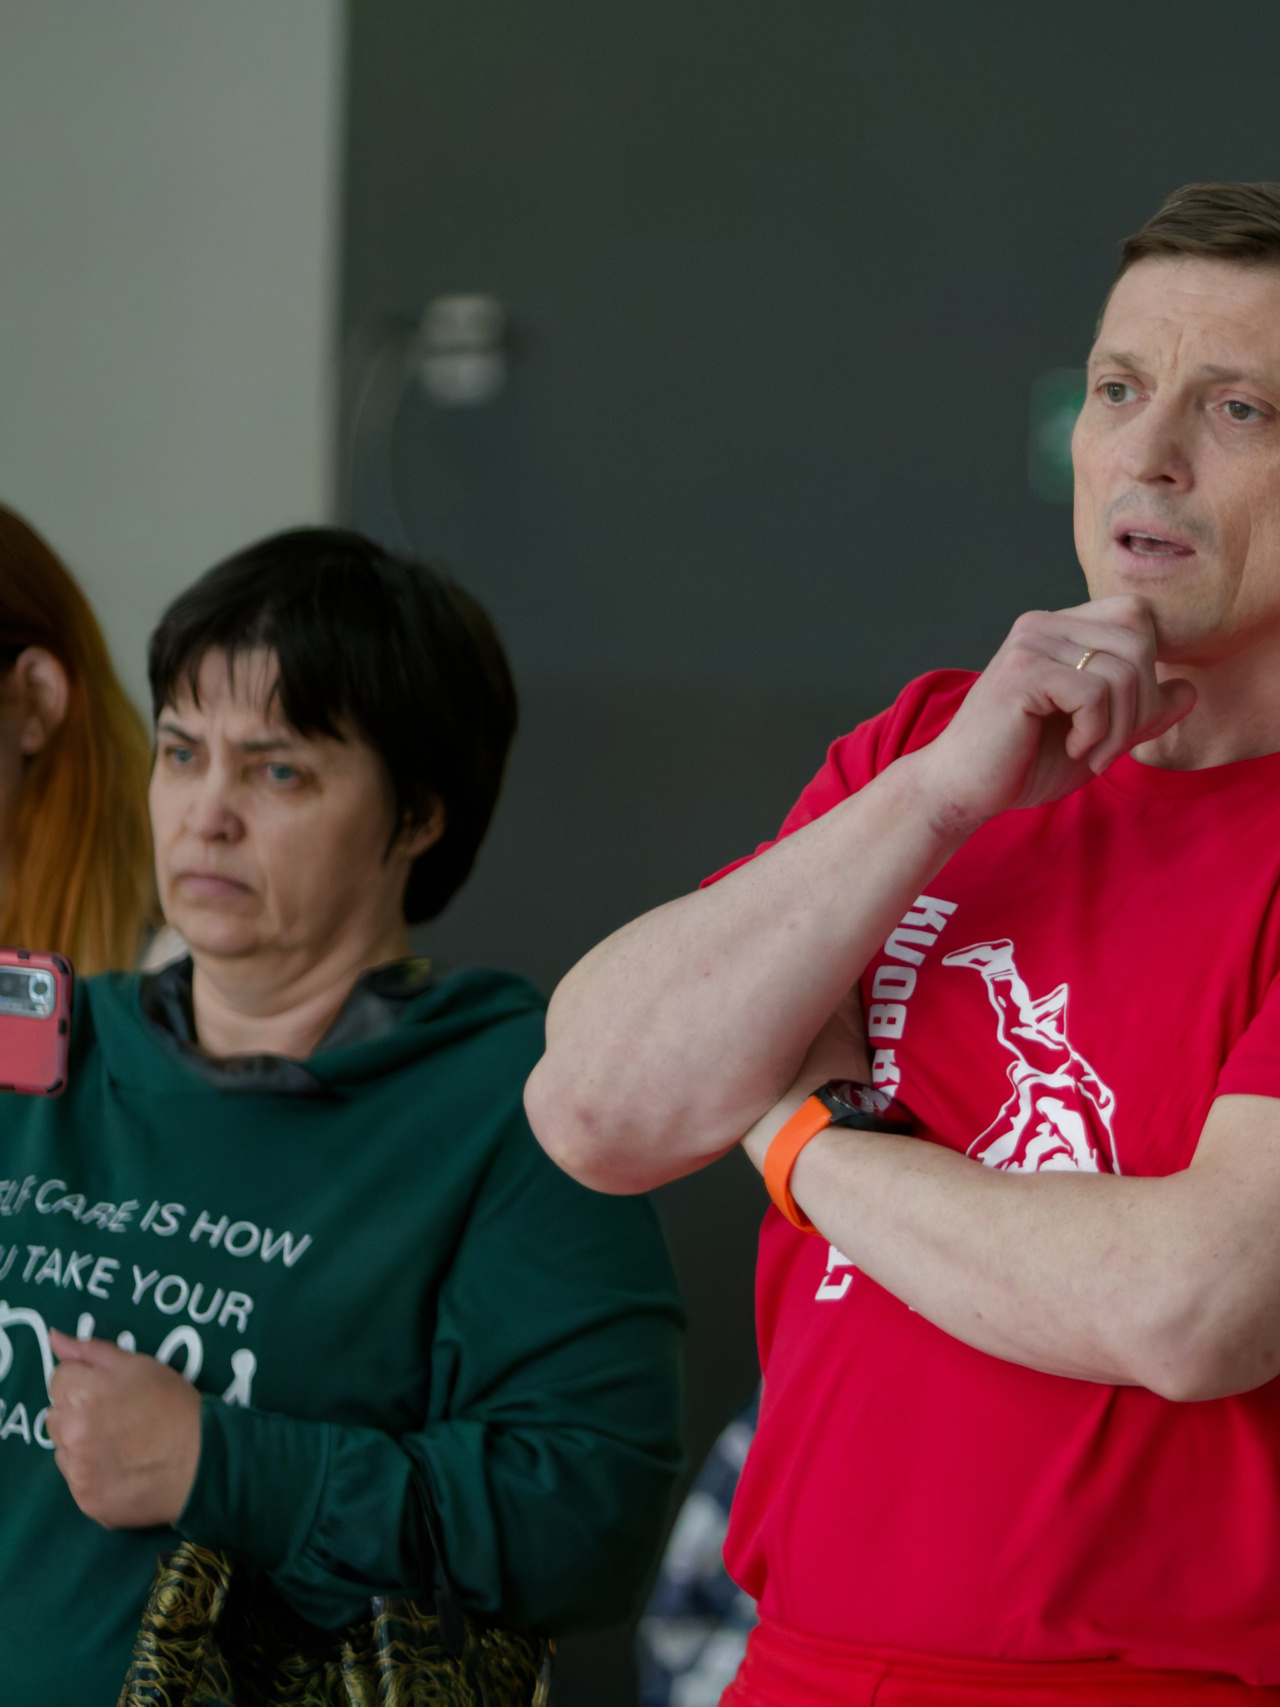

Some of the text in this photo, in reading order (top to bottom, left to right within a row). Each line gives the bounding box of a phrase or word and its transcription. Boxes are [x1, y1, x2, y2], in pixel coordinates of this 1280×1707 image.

[35, 1178, 140, 1232] CARE
[140, 1200, 187, 1236] IS
[189, 1210, 313, 1267] HOW
[22, 1244, 121, 1299] TAKE
[131, 1264, 254, 1333] YOUR
